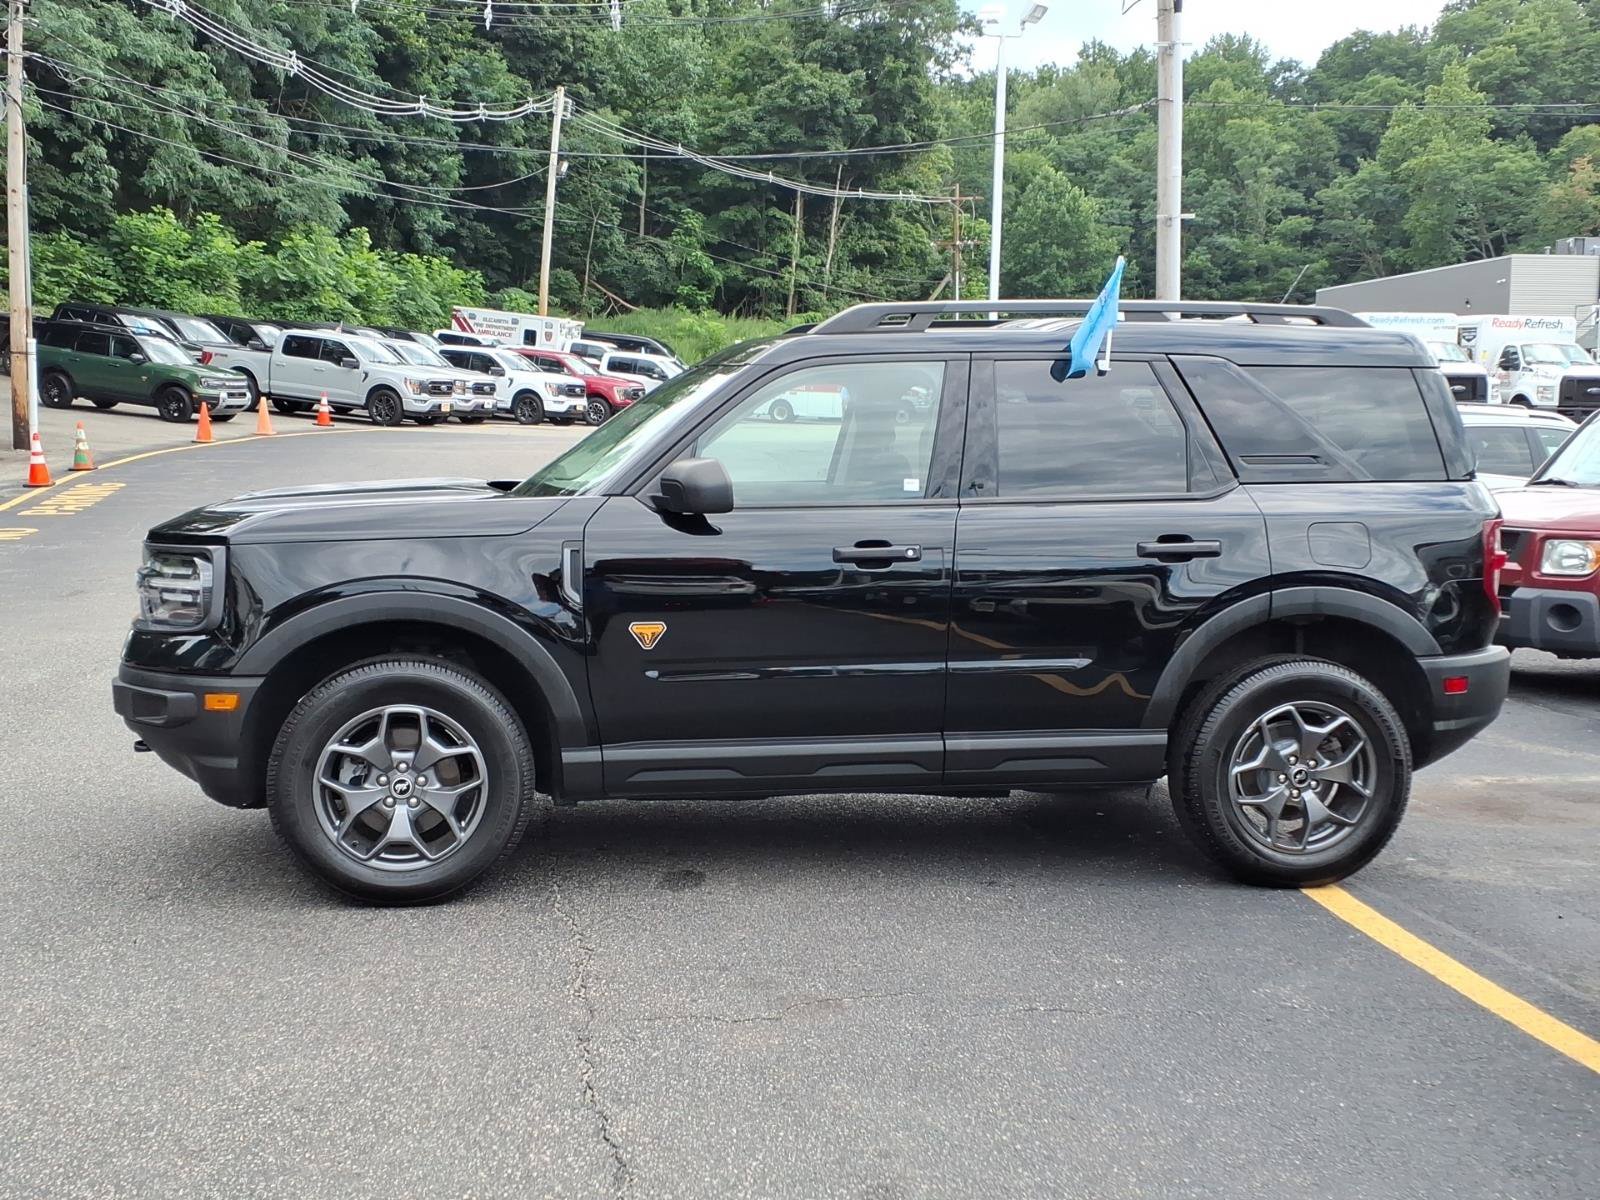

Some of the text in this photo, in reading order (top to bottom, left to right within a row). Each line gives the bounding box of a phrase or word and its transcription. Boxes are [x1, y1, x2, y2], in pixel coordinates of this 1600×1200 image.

[1368, 315, 1445, 326] ReadyRefresh.com
[1491, 317, 1564, 330] ReadyRefresh
[476, 329, 513, 338] AMBULANCE
